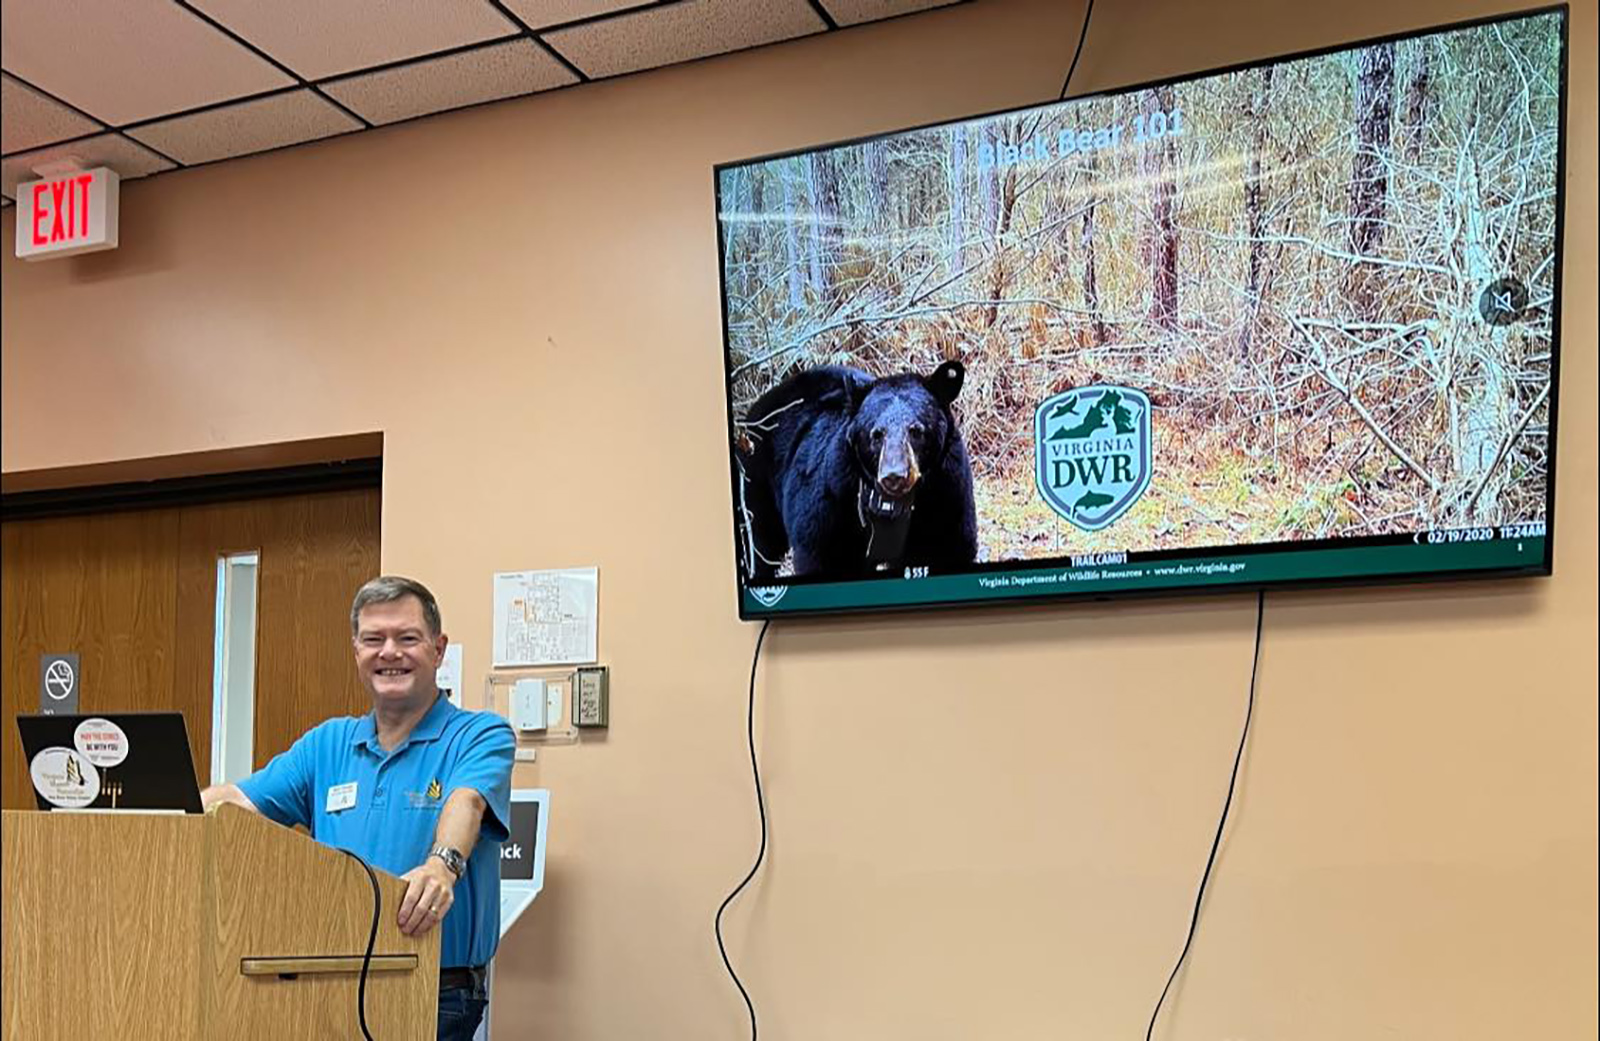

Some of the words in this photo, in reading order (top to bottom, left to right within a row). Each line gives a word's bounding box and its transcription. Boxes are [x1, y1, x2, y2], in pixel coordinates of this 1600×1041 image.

[978, 133, 1050, 168] Black
[1058, 124, 1123, 155] Bear
[1132, 108, 1184, 143] 101
[32, 174, 93, 246] EXIT
[1052, 438, 1134, 456] VIRGINIA
[1052, 453, 1136, 489] DWR
[1427, 527, 1494, 544] 02/19/2020
[1499, 523, 1546, 539] 11:24AM
[979, 575, 1009, 588] Virginia
[1011, 574, 1057, 587] Department
[1058, 571, 1067, 582] of
[1068, 570, 1100, 581] Wildlife
[1102, 569, 1142, 580] Resources
[1154, 561, 1246, 576] www.dwr.virginia.gov
